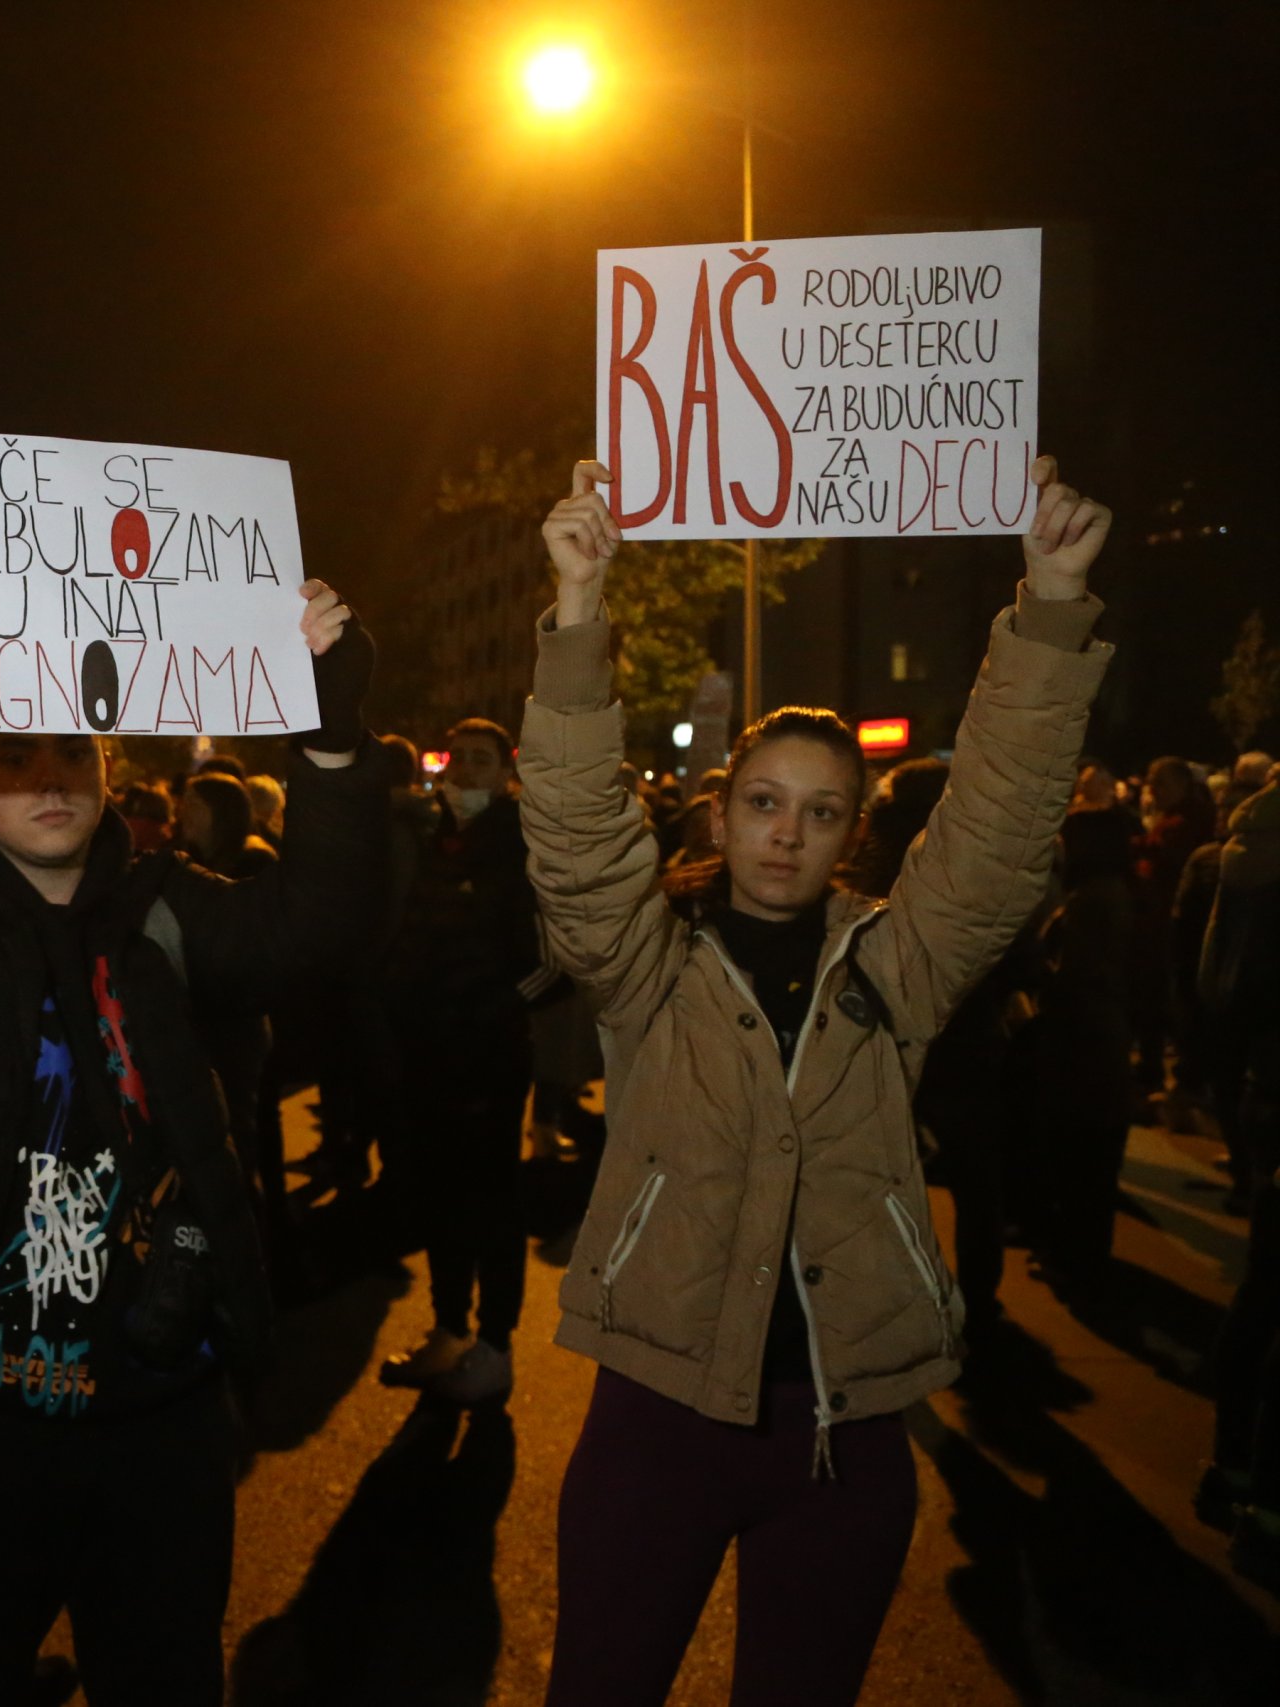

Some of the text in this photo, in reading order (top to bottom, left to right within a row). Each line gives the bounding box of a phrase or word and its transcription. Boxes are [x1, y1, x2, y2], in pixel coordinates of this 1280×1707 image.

[781, 319, 998, 369] U DESETERCU
[608, 246, 793, 530] BAŠ
[792, 373, 1024, 433] ZA BUDUĆNOST
[104, 454, 178, 510] SE
[797, 438, 1030, 534] NAŠU DECU
[820, 438, 870, 478] ZA
[61, 576, 180, 641] INAT
